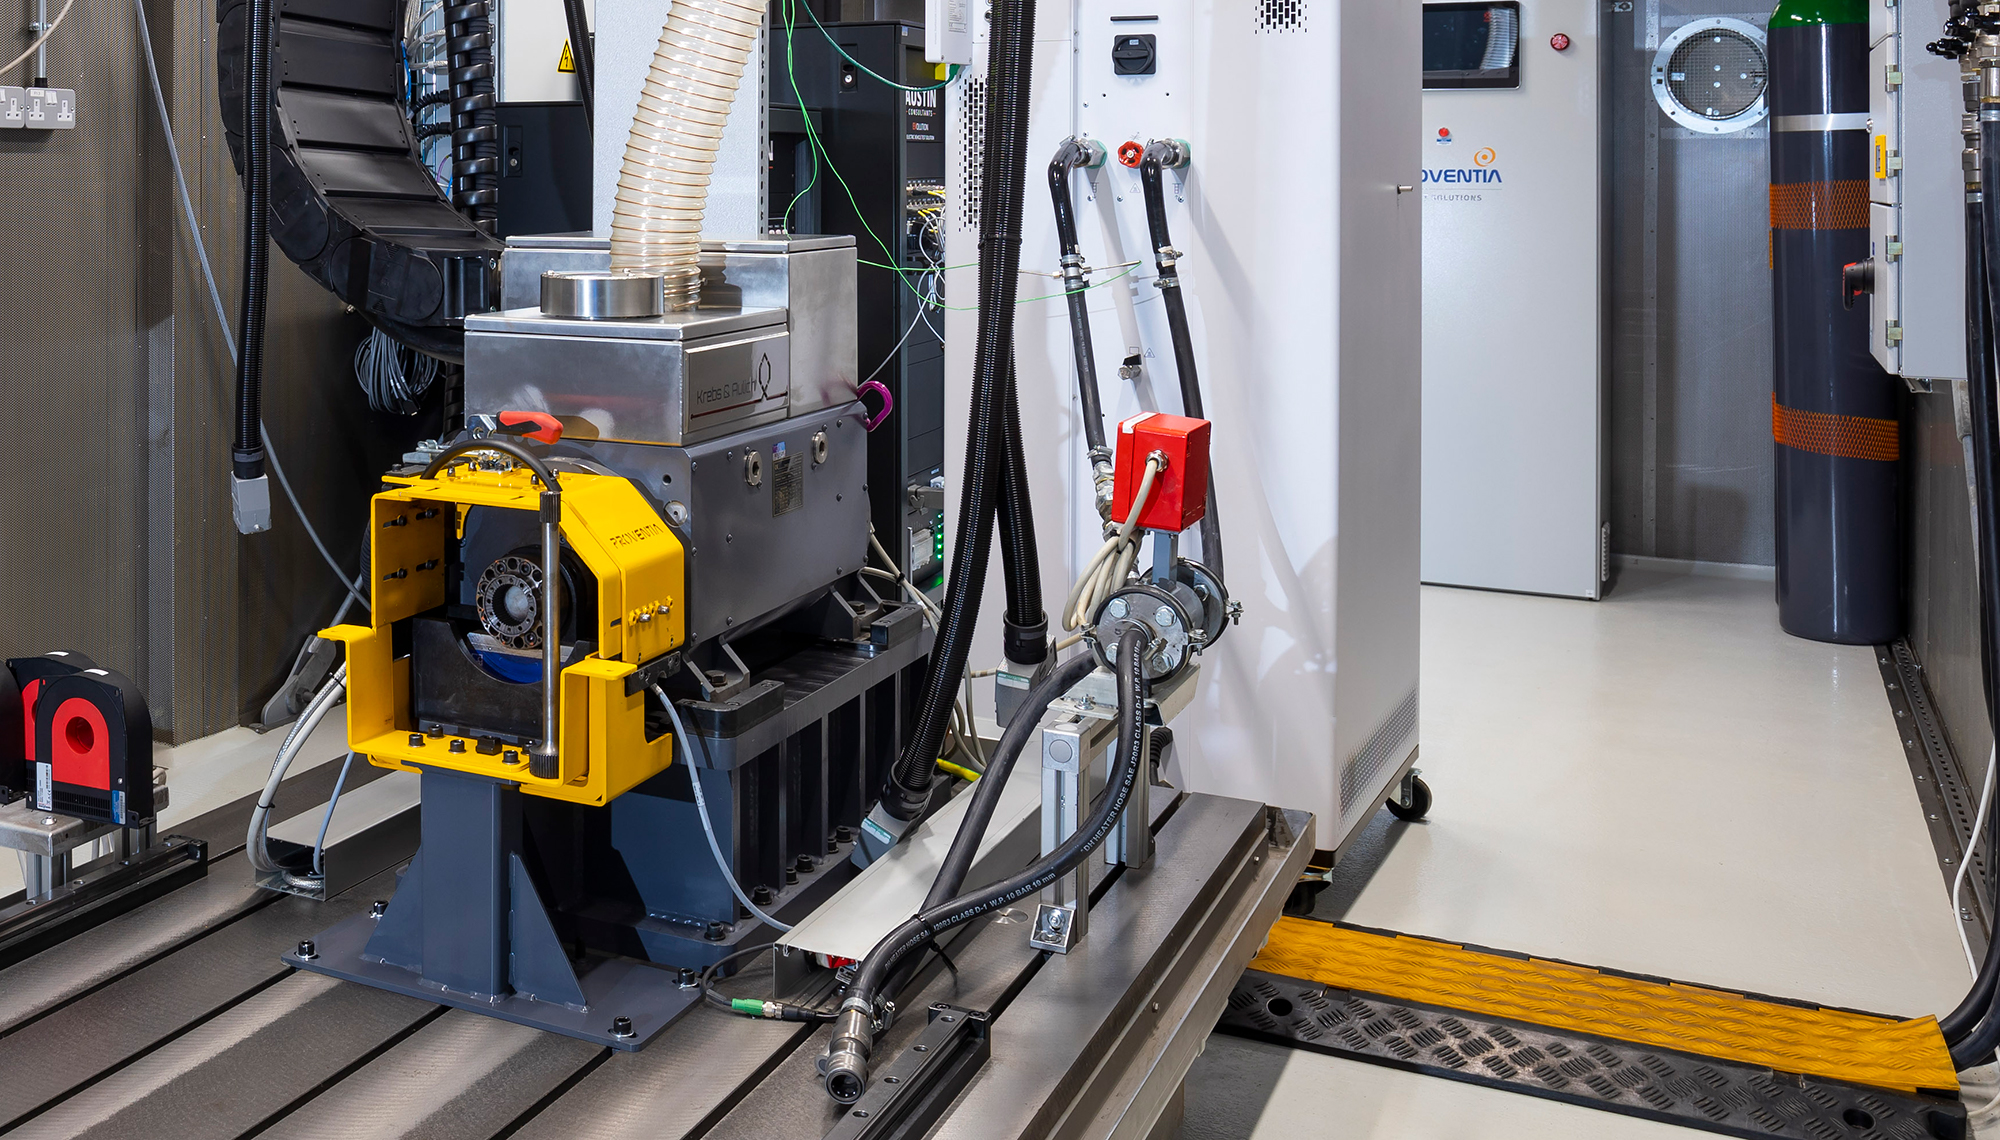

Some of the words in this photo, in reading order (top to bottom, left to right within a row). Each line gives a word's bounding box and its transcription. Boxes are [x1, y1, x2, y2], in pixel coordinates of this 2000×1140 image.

[905, 89, 937, 108] AUSTIN
[696, 386, 722, 405] Krebs
[723, 384, 731, 399] &
[609, 523, 664, 549] PROVENTIA
[1134, 709, 1142, 739] CLASS
[1131, 740, 1141, 767] J20R3
[1124, 767, 1136, 787] SAE
[1113, 786, 1129, 811] HOSE
[1092, 810, 1117, 843] HEATER
[905, 935, 920, 948] HOSE
[951, 908, 975, 923] CLASS
[974, 903, 988, 914] D-1
[989, 896, 1006, 908] W.P.
[1006, 892, 1016, 901] 10
[1015, 884, 1033, 897] BAR
[1041, 872, 1056, 884] mm
